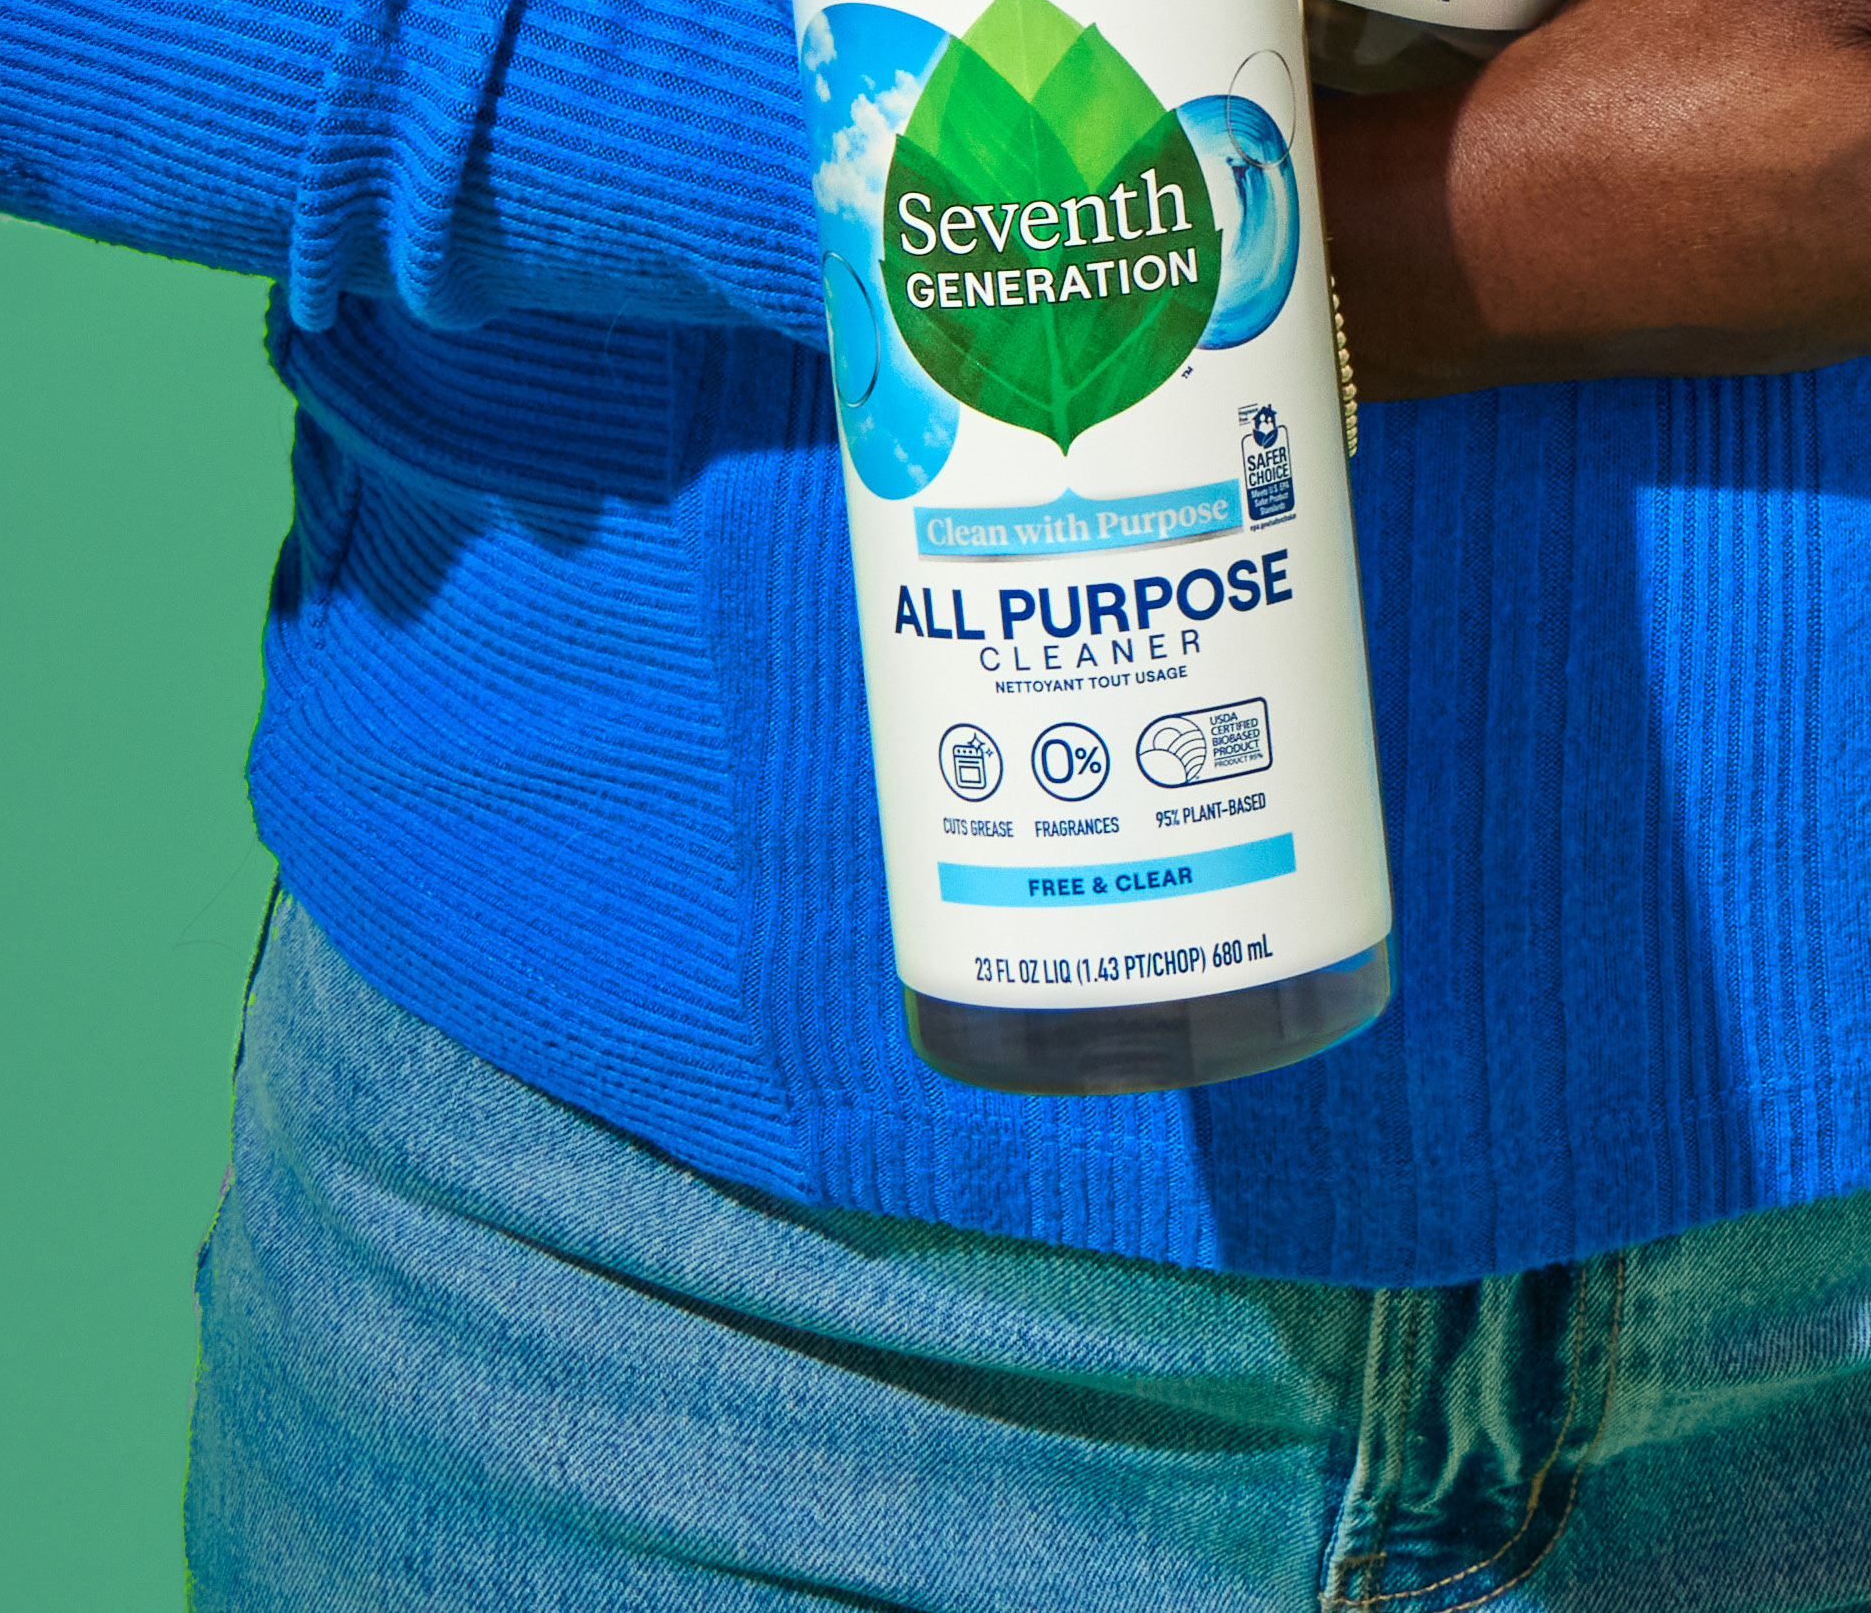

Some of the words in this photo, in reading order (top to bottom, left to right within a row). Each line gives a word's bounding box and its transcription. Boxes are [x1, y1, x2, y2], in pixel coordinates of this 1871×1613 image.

[898, 168, 1192, 255] Seventh
[906, 248, 1198, 308] GENERATION
[1248, 446, 1287, 471] SAFER
[1248, 463, 1289, 487] CHOICE
[928, 519, 1011, 546] Clean
[1015, 512, 1090, 544] with
[1095, 499, 1229, 539] Purpose
[895, 585, 986, 640] ALL
[999, 549, 1293, 640] PURPOSE
[979, 629, 1201, 671] CLEANER
[995, 677, 1084, 694] NETTOYANT
[1088, 673, 1131, 690] TOUT
[1135, 665, 1188, 684] USAGE
[1210, 712, 1238, 725] USDA
[1211, 718, 1258, 736] CERTIFIED
[1212, 728, 1260, 747] BIOBASED
[1213, 739, 1259, 757] PRODUCT
[1041, 739, 1102, 783] 0%
[1214, 755, 1248, 768] PRODUCT
[1156, 809, 1180, 828] 95%
[1182, 792, 1266, 824] PLANT-BASED
[943, 817, 968, 836] CUTS
[970, 820, 1014, 837] GREASE
[1035, 817, 1120, 837] FRAGRANCES
[1029, 878, 1084, 896] FREE
[1092, 876, 1108, 894] &
[1116, 867, 1192, 891] CLEAR
[975, 957, 992, 982] 23
[996, 959, 1015, 983] FL
[1019, 960, 1039, 984] OZ
[1043, 959, 1072, 983] LIQ
[1077, 956, 1119, 986] (1.43
[1124, 946, 1206, 980] PT/CHOP)
[1212, 939, 1243, 968] 680
[1247, 933, 1273, 962] mL
